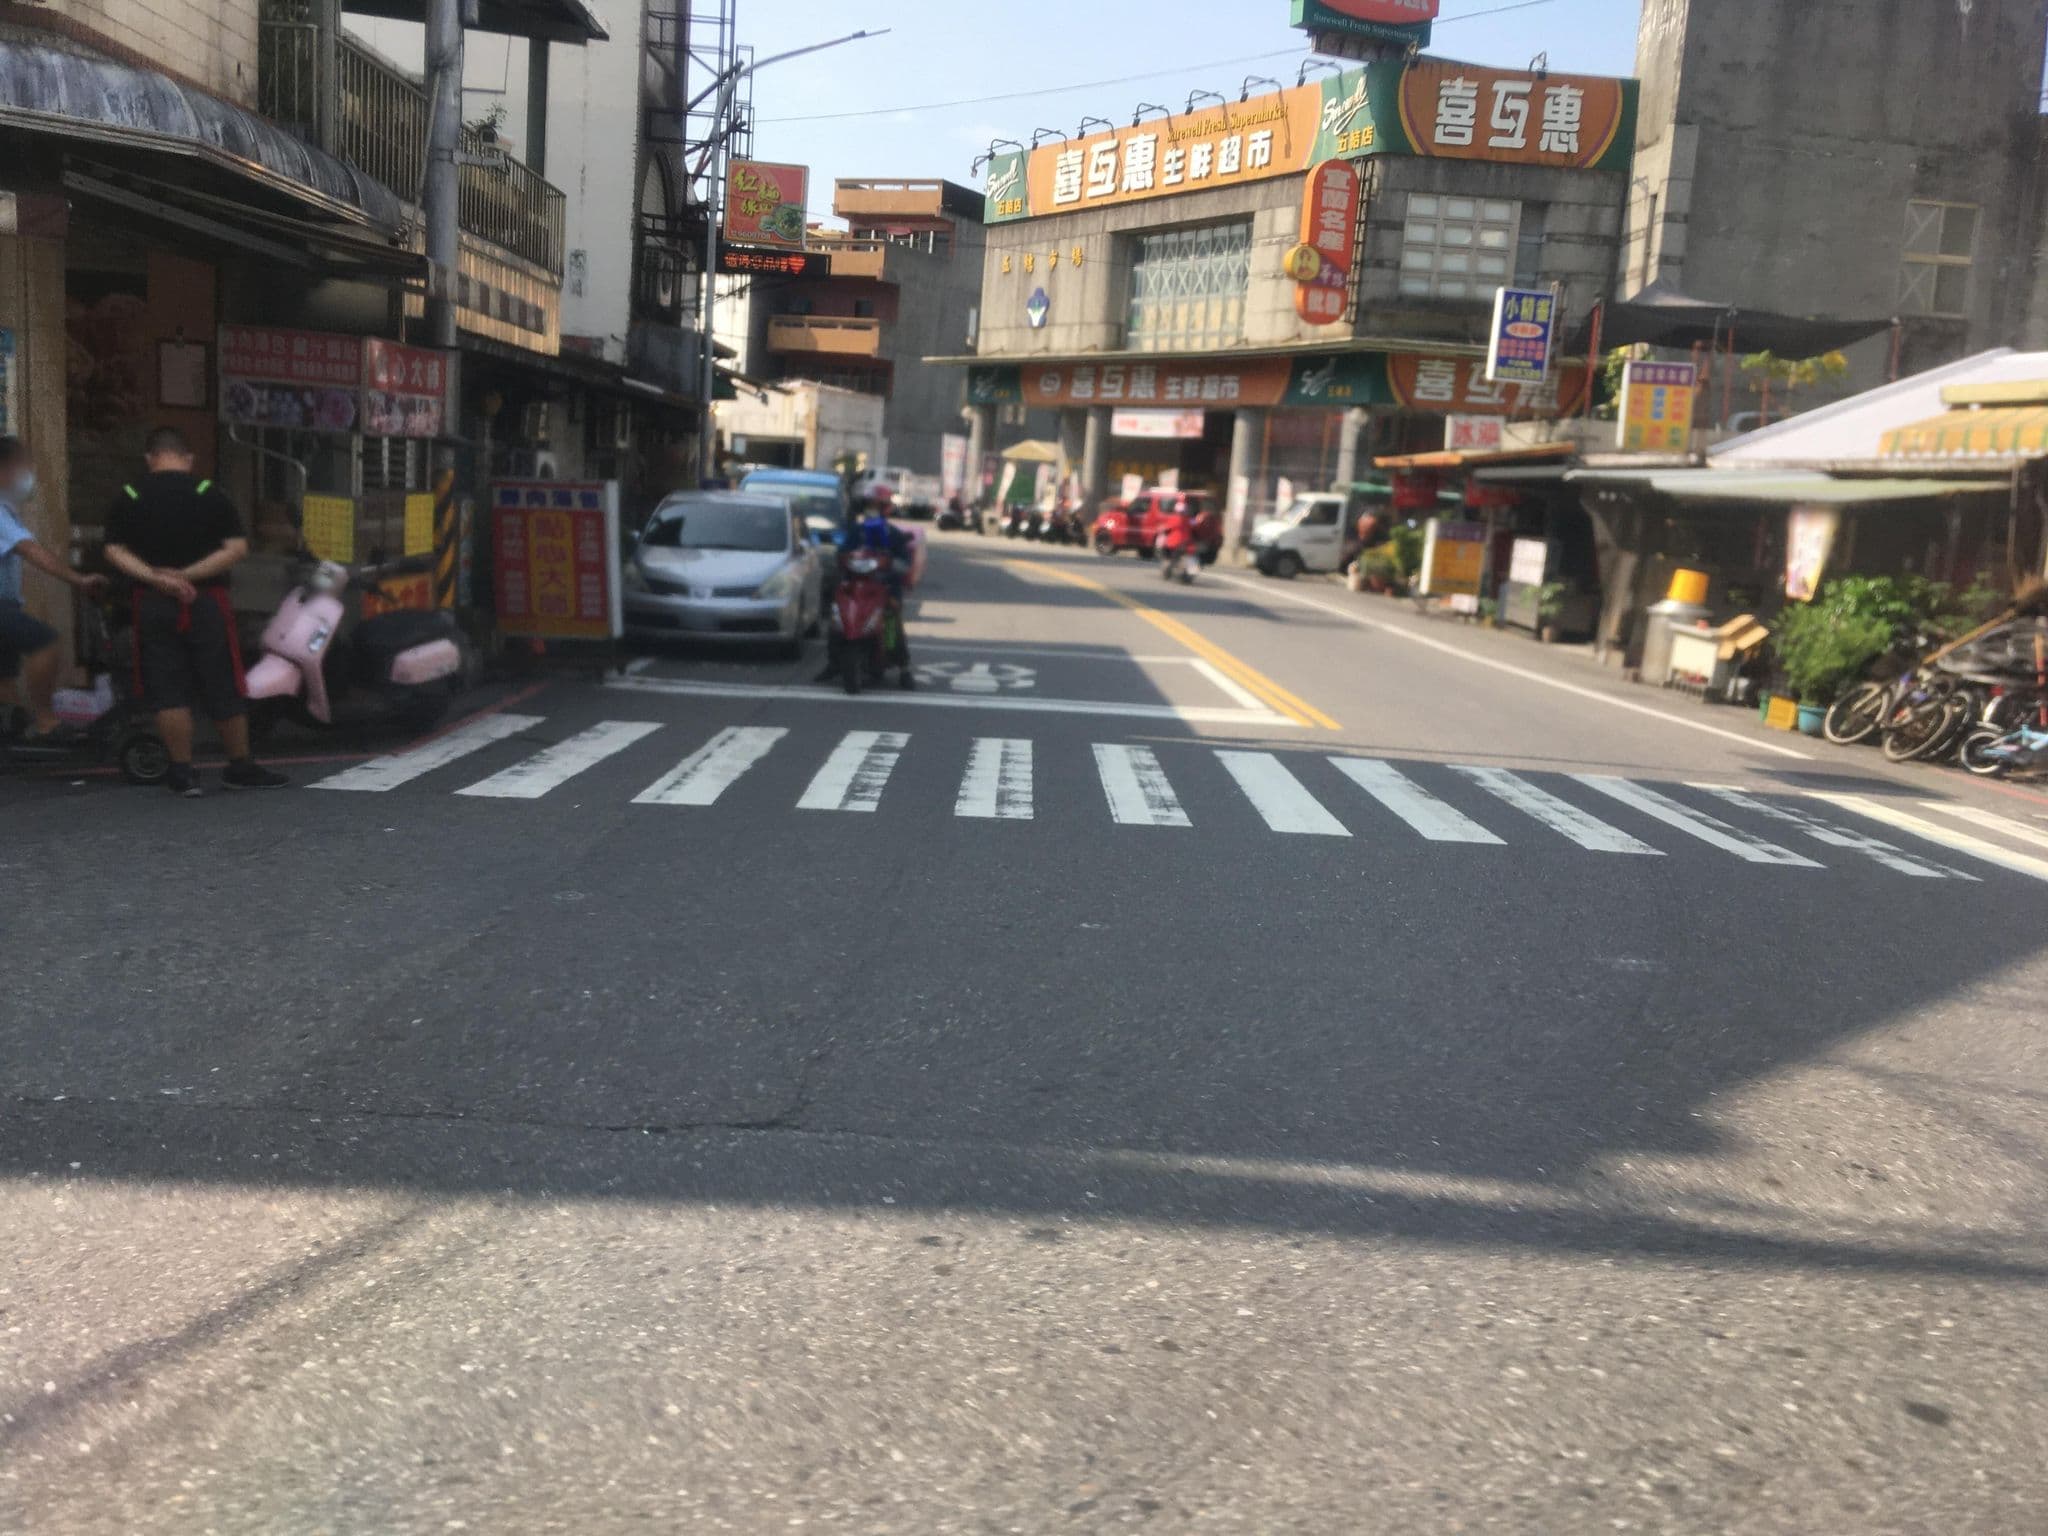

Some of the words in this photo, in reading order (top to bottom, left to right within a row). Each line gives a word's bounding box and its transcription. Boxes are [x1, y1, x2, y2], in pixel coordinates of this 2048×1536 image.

[1433, 76, 1584, 153] 喜互惠
[1053, 133, 1158, 205] 喜互惠
[1162, 129, 1274, 186] 生鮮超市
